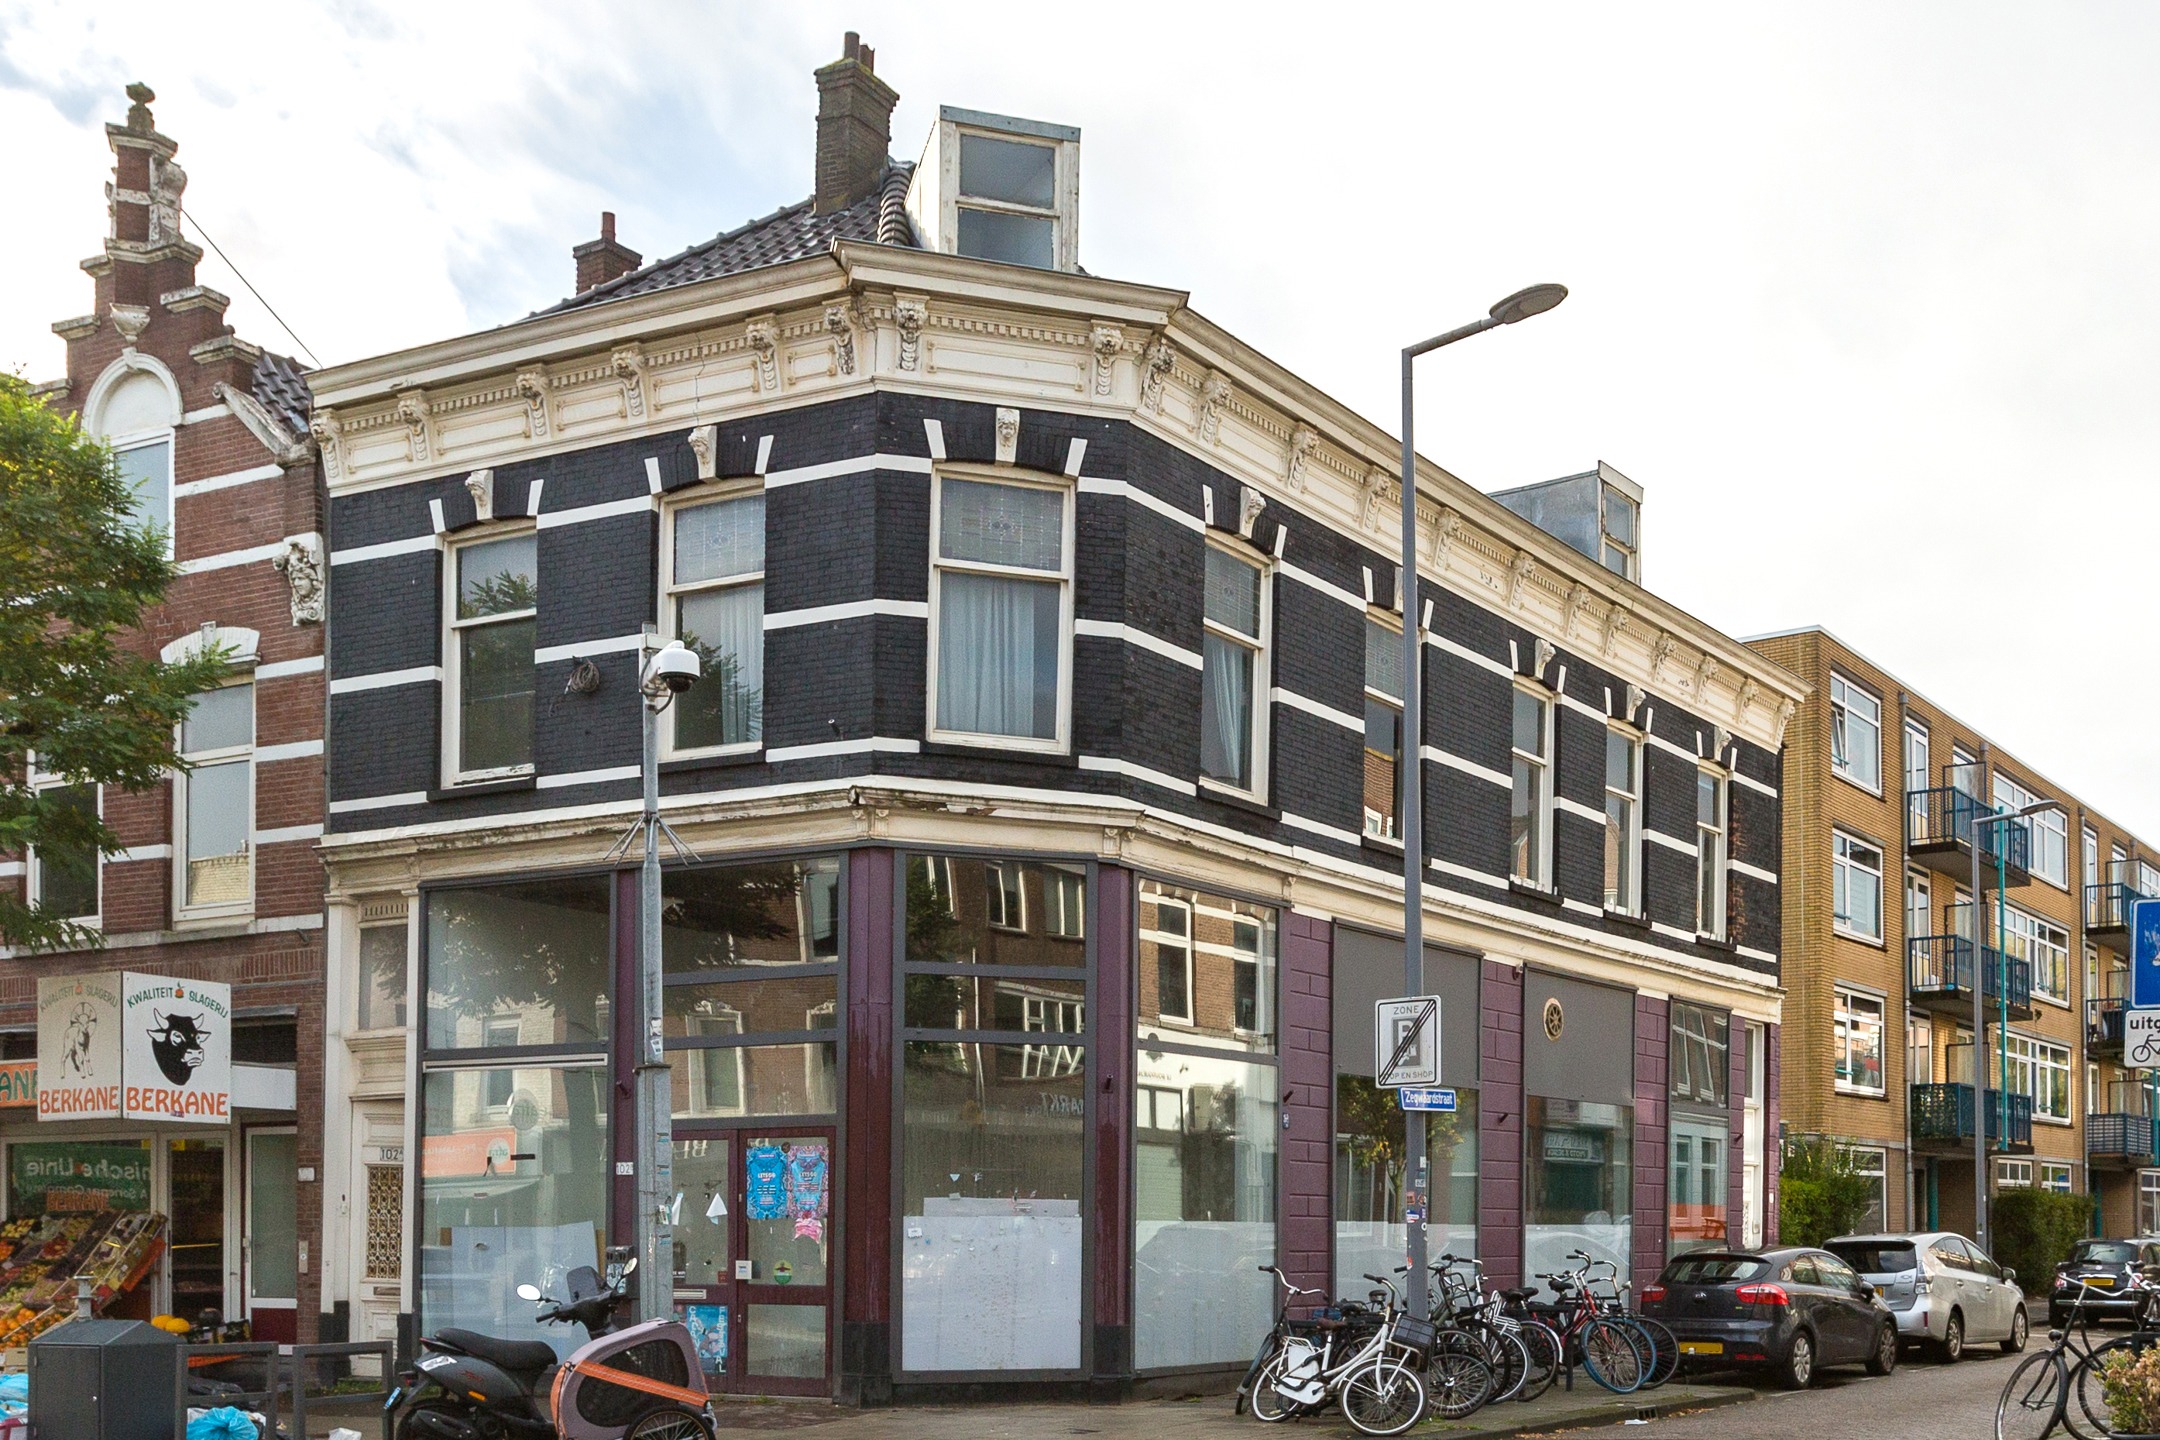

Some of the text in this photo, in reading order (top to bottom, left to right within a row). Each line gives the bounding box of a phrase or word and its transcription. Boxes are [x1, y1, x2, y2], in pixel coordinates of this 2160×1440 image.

[126, 987, 229, 1019] KWALITEIT SLAGERIJ
[1393, 1005, 1420, 1015] ZONE
[1401, 1071, 1412, 1079] EN
[1412, 1070, 1433, 1078] SHOP
[39, 1086, 119, 1114] BERKANE
[125, 1086, 229, 1117] BERKANE
[1405, 1091, 1453, 1106] Zegwaardstraat
